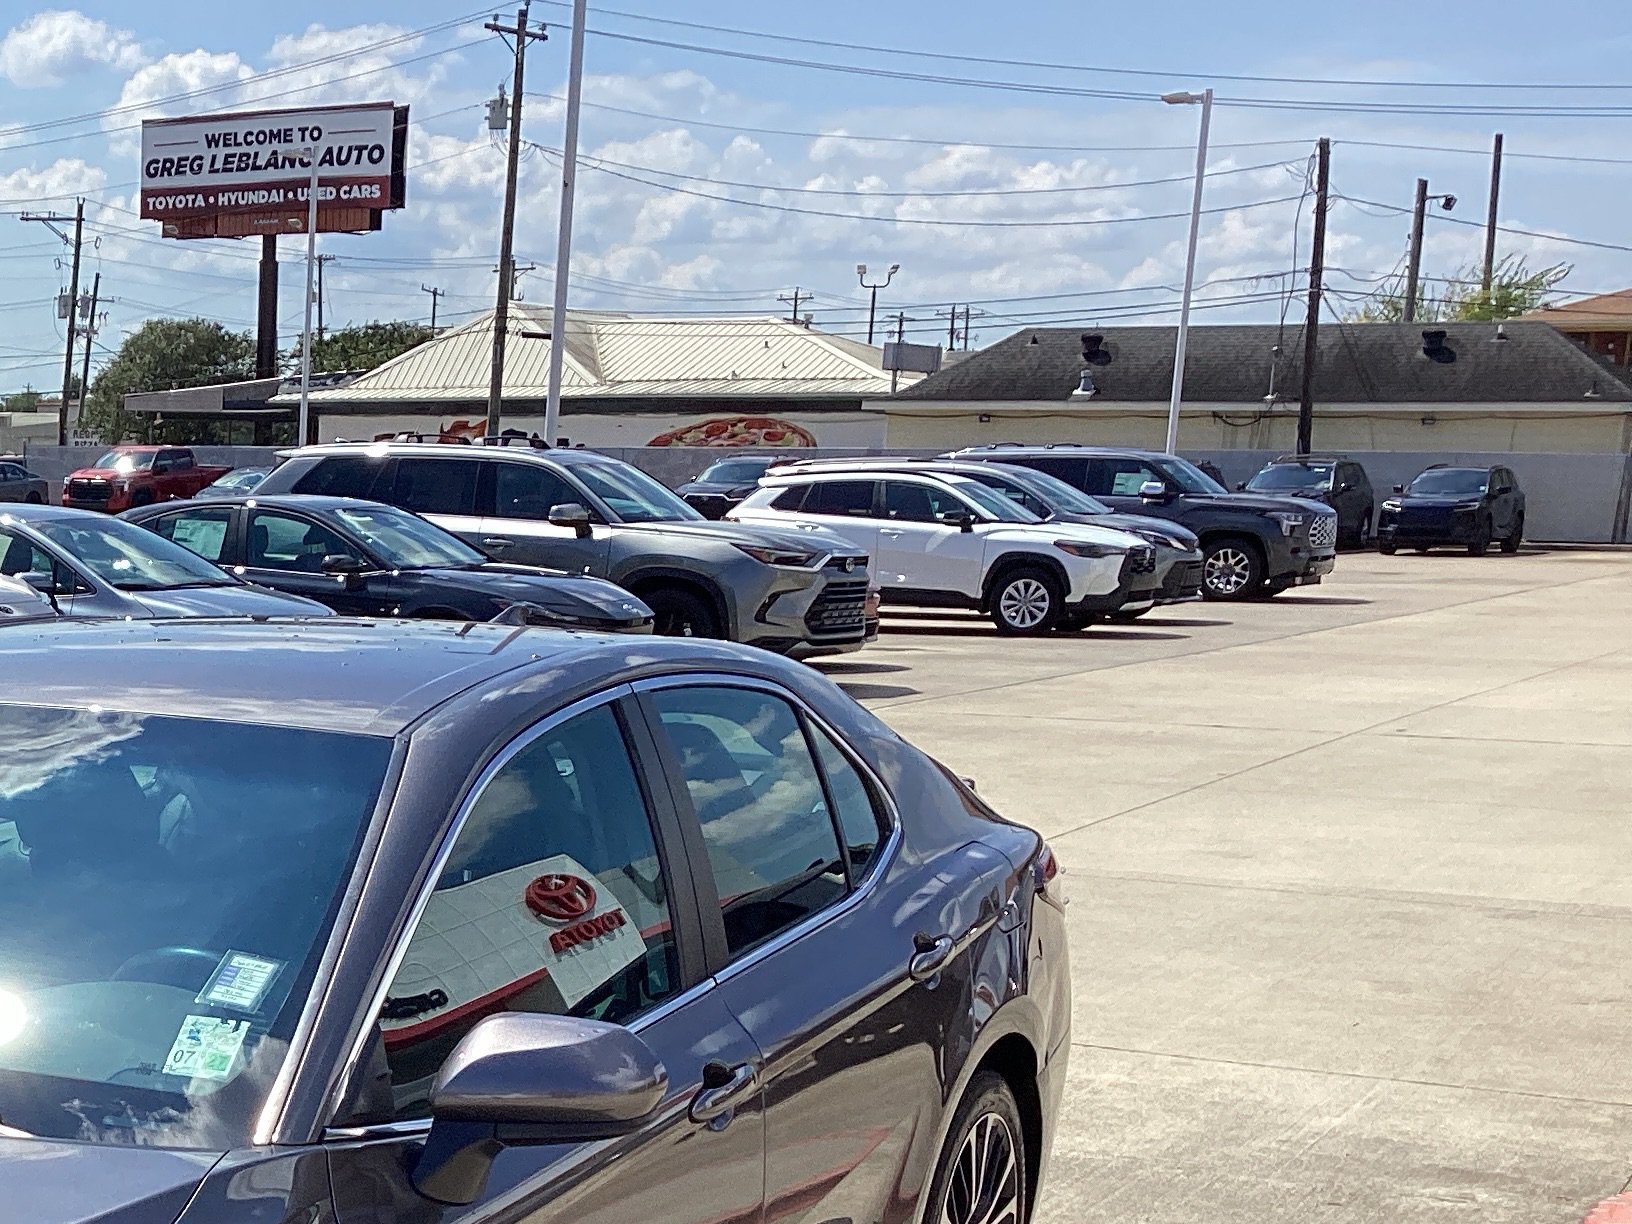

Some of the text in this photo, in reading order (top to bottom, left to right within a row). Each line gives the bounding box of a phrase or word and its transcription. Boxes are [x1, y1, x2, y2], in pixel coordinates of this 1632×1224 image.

[205, 126, 322, 149] WELCOME TO
[145, 144, 385, 178] GREG LEBLANC AUTO
[147, 194, 205, 210] TOYOTA
[218, 189, 285, 206] HYUNDAI
[340, 184, 381, 200] CARS
[173, 1049, 197, 1064] 07
